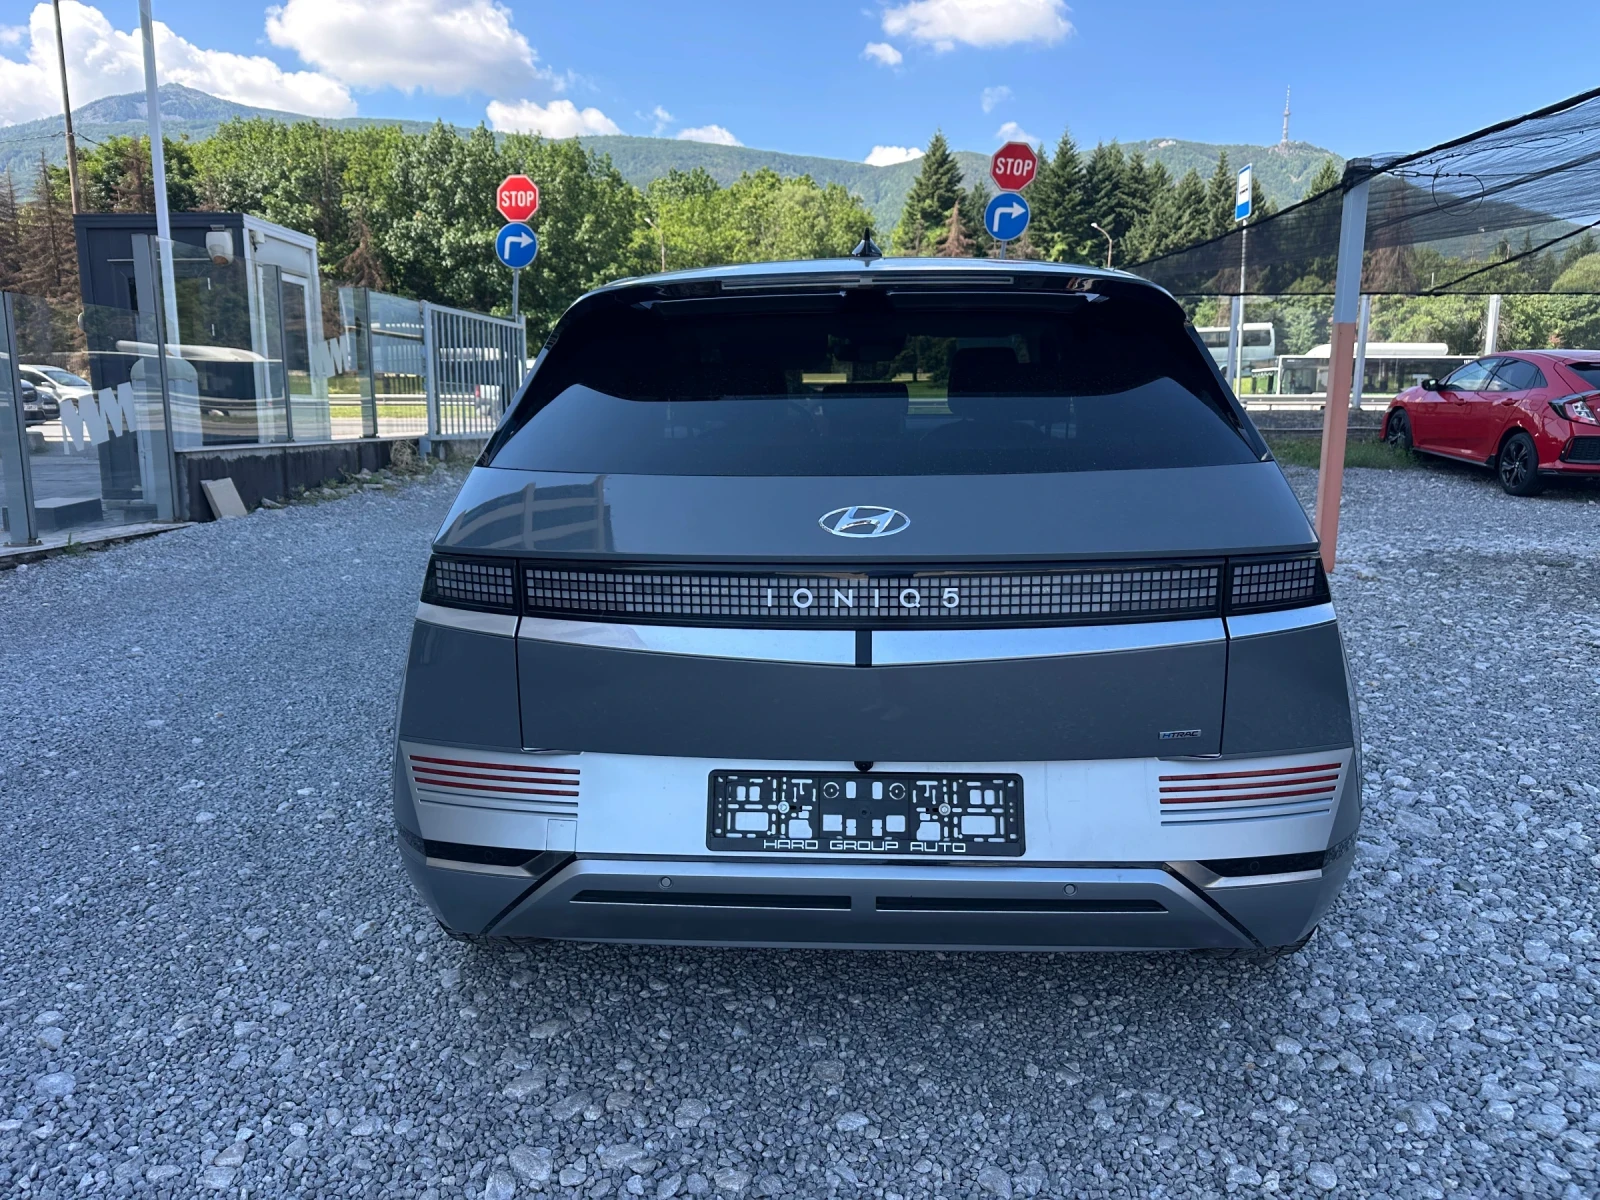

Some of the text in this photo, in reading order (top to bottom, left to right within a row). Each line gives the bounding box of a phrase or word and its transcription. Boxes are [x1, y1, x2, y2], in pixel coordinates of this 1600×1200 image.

[995, 157, 1033, 177] STOP
[501, 190, 535, 207] STOP
[767, 588, 959, 608] IONIQ 5
[1162, 730, 1200, 739] HTRAC
[763, 838, 966, 853] HARD GROUP AUTO
